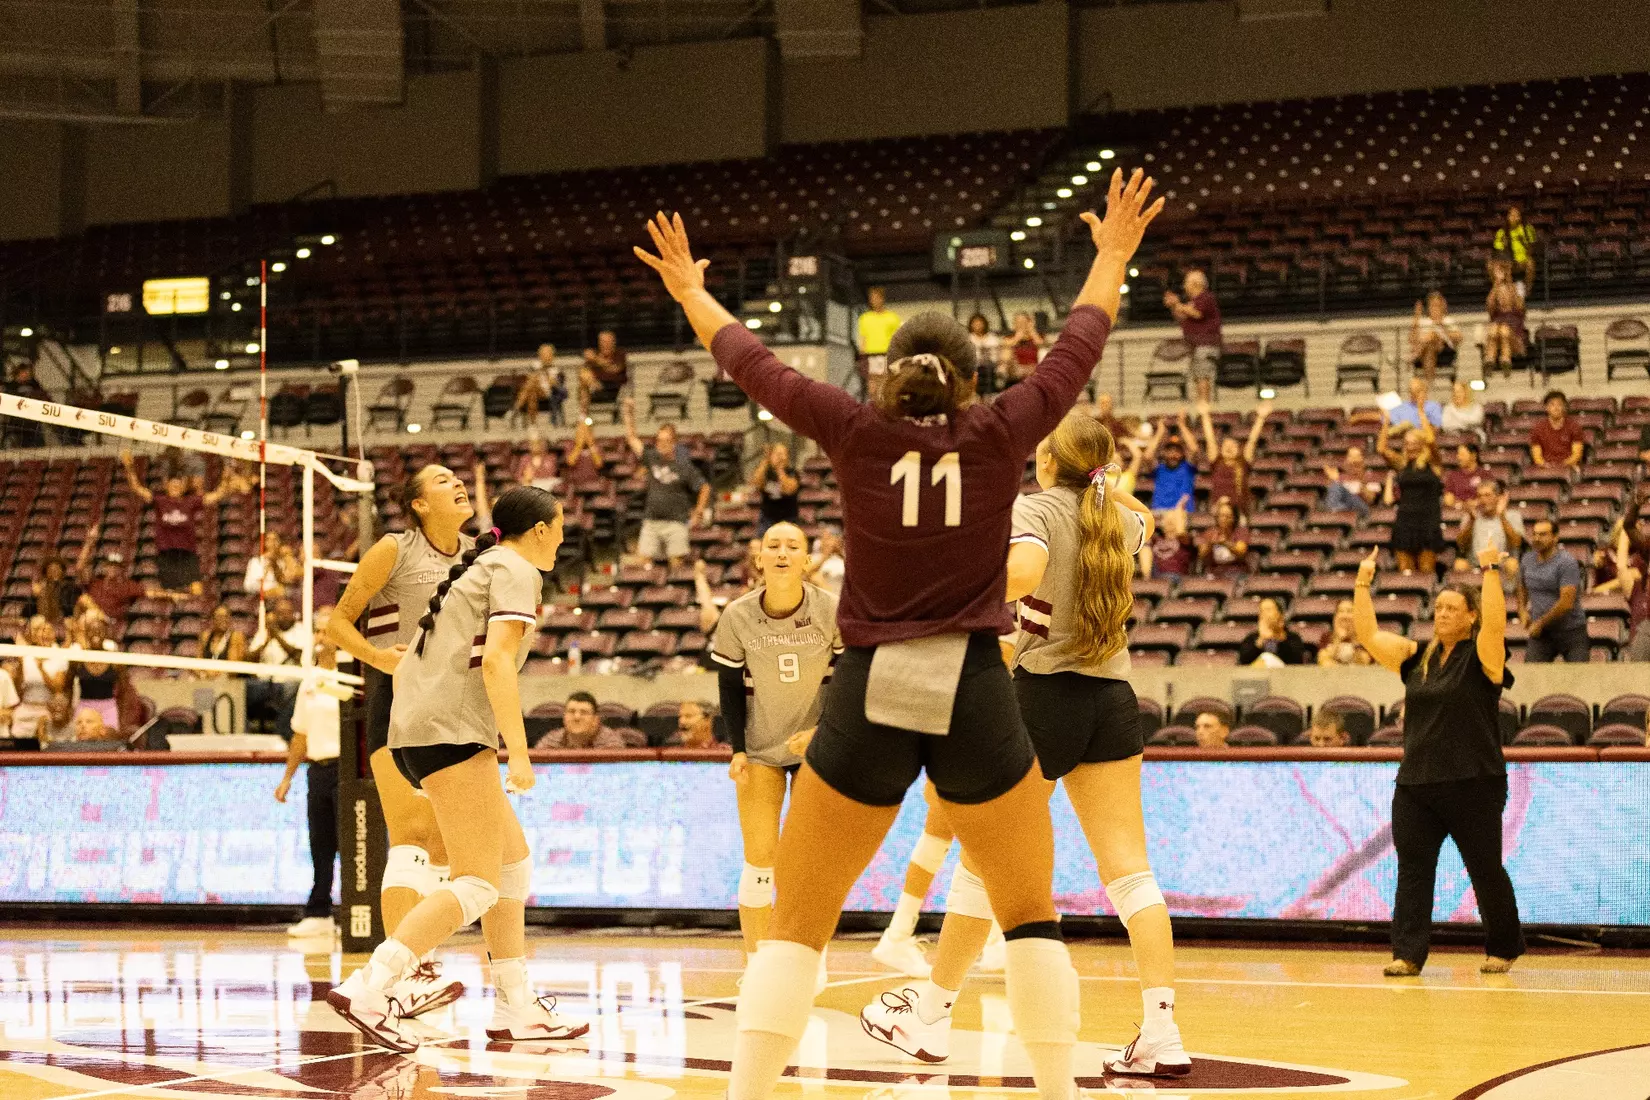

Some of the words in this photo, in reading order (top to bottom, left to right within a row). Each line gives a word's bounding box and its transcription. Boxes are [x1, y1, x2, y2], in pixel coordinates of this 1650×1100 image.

[41, 403, 62, 418] SIU
[98, 414, 117, 428] SIU
[152, 424, 169, 437] SIU
[202, 433, 219, 446] SIU
[890, 450, 962, 527] 11
[747, 634, 790, 651] SOUTHERN
[790, 632, 825, 647] ILLINOIS
[777, 652, 800, 683] 9
[354, 799, 367, 841] sports
[354, 840, 367, 892] imports
